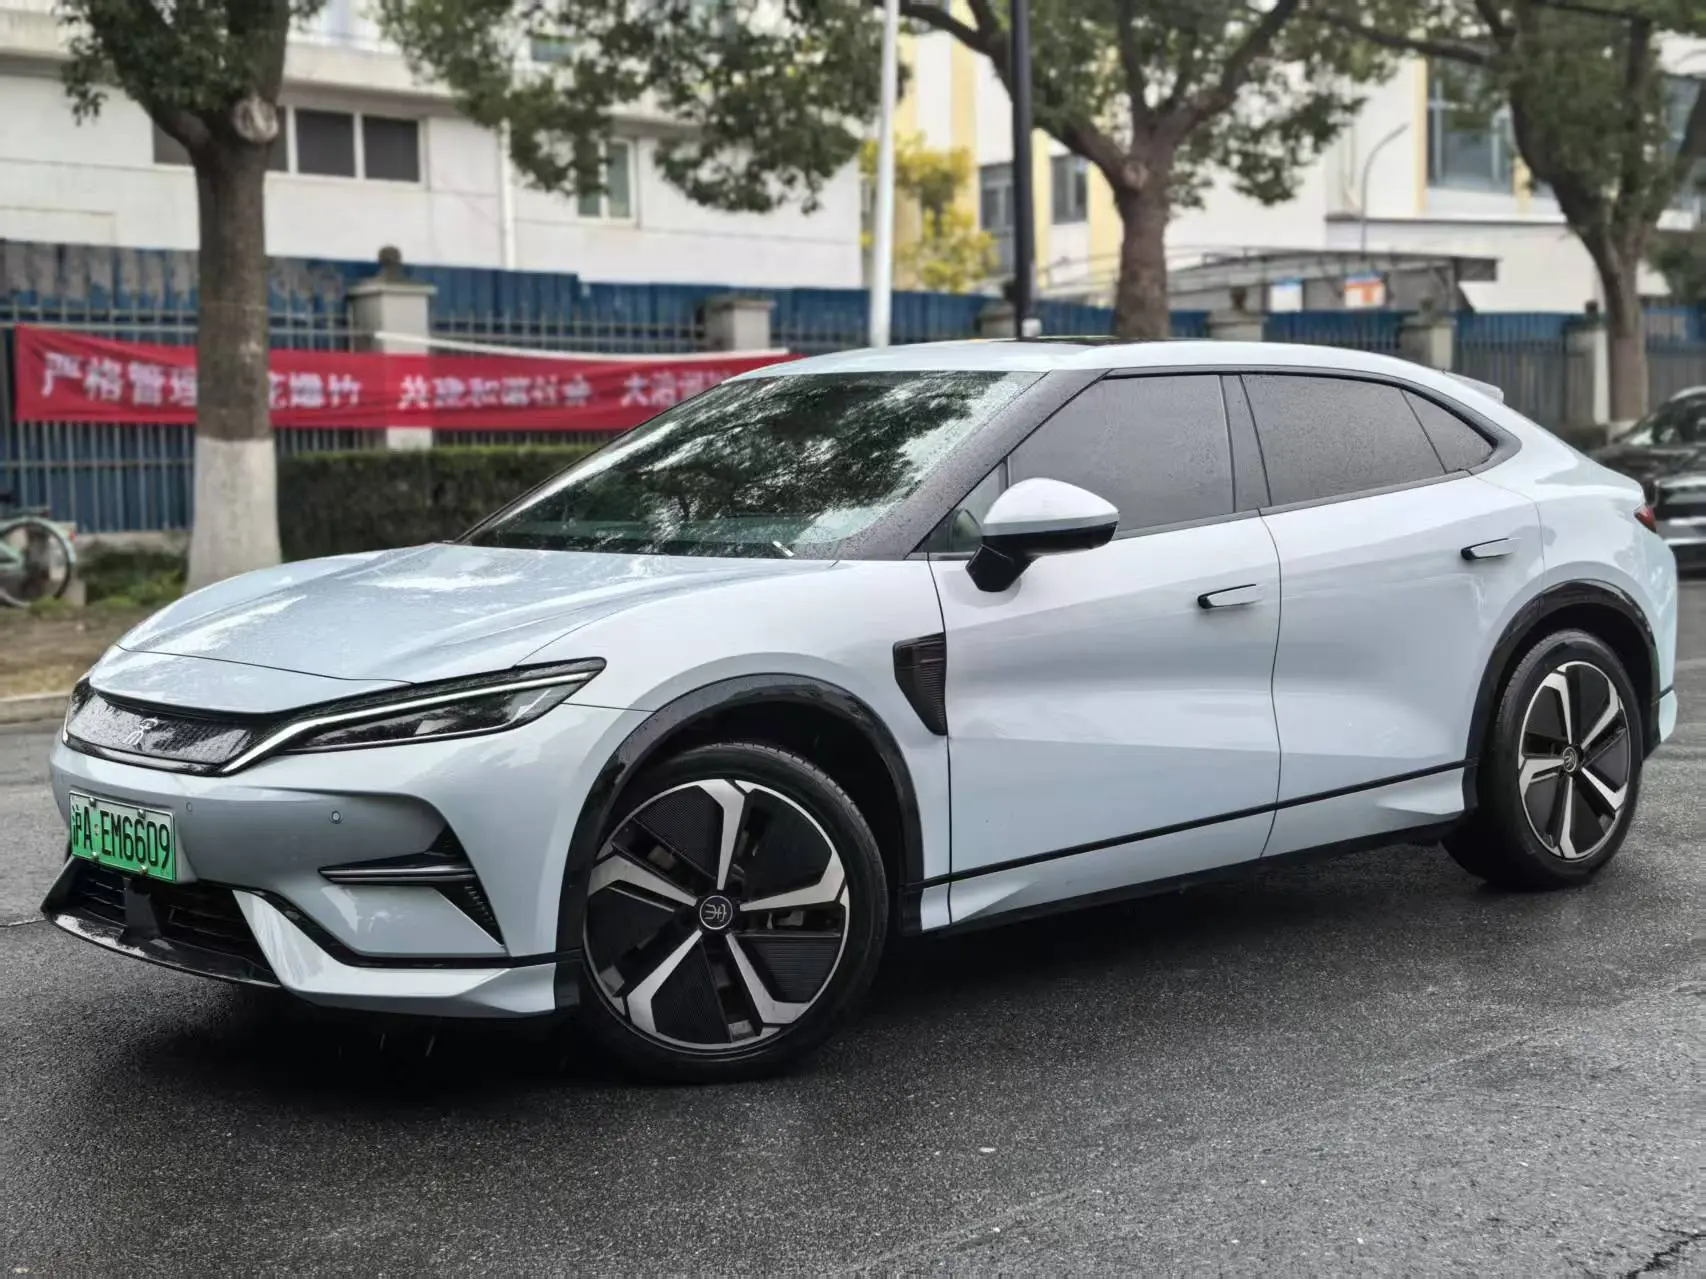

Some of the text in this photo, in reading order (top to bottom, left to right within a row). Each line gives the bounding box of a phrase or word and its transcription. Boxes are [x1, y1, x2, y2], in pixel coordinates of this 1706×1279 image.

[40, 352, 363, 408] 严格管理花爆竹
[100, 810, 170, 869] EM6609
